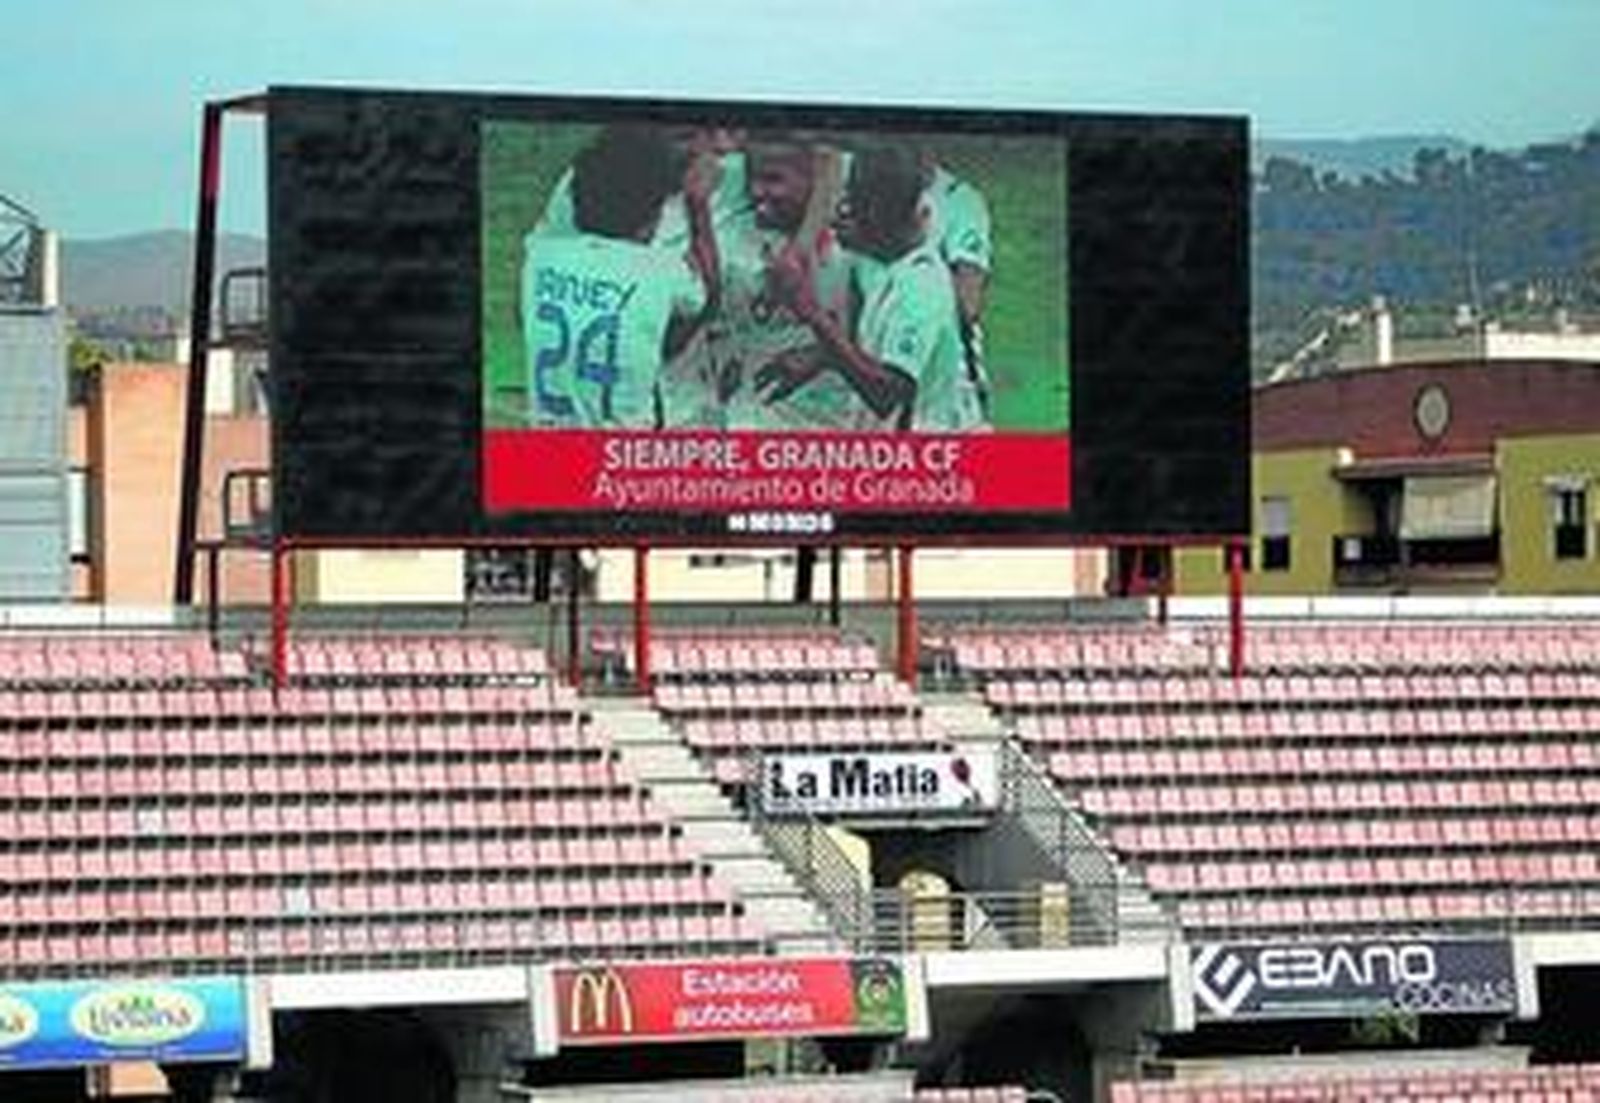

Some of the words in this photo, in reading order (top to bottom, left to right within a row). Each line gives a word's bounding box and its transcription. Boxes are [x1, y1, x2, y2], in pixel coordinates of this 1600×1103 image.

[535, 301, 622, 420] 24
[757, 440, 915, 471] GRANADA
[921, 441, 962, 471] CF
[592, 471, 804, 510] Ayuntamiento
[810, 471, 847, 502] de
[854, 471, 975, 502] Granada
[770, 761, 818, 799] La
[682, 967, 800, 996] Estación
[1258, 945, 1436, 987] EBANO
[1396, 979, 1515, 1012] COCINAS
[672, 1001, 814, 1029] autobuses
